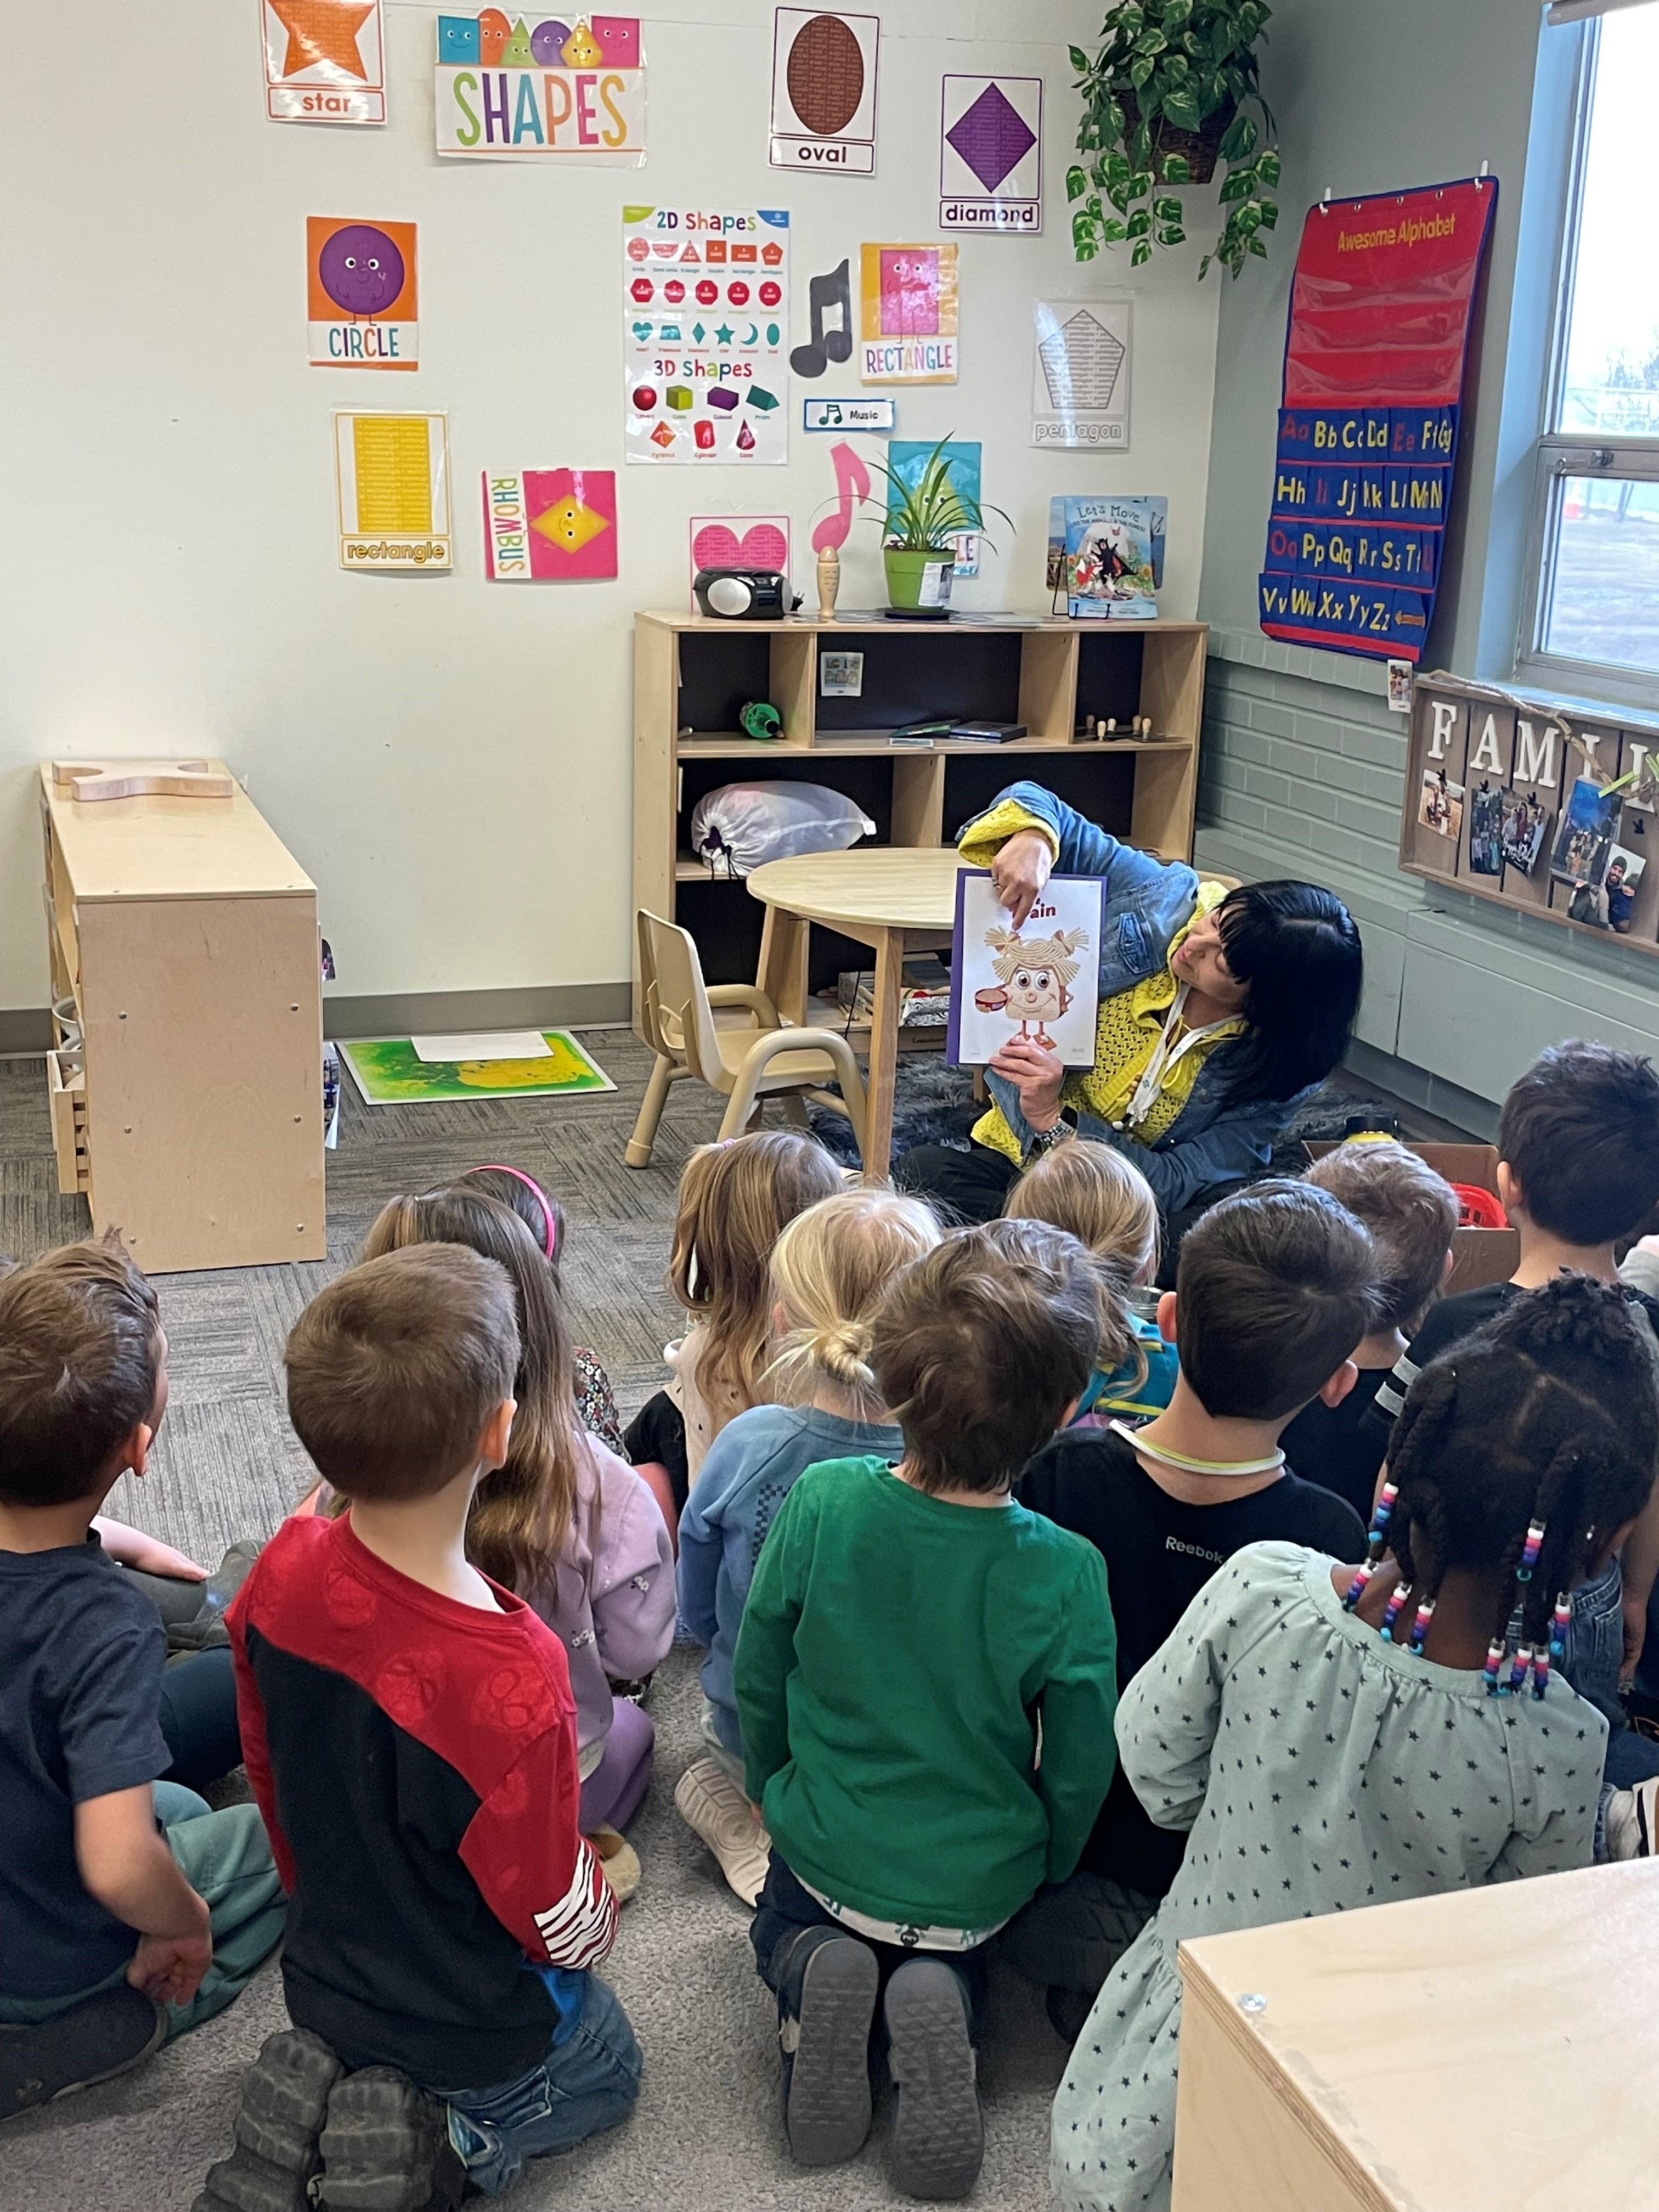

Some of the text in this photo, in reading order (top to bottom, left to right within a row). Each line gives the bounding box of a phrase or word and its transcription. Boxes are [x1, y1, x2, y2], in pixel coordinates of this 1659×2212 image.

[302, 93, 351, 112] star
[453, 72, 628, 147] SHAPES
[798, 145, 847, 163] oval
[657, 211, 757, 235] 2D Shapes
[945, 204, 1034, 223] diamond
[1337, 212, 1456, 253] Awesome Alphabet
[329, 328, 399, 358] CIRCLE
[654, 359, 753, 382] 3D Shapes
[866, 344, 952, 374] RECTANGLE
[850, 409, 878, 420] Music
[1035, 421, 1121, 443] pentagon
[1281, 414, 1310, 442] Aa
[1314, 420, 1337, 448] Bb
[1342, 420, 1364, 448] Cc
[1277, 476, 1306, 504] Hh
[1337, 479, 1356, 516] Jj
[491, 478, 525, 572] RHOMBUS
[1077, 505, 1140, 523] Let's Move
[347, 541, 445, 564] rectangle
[1271, 530, 1297, 558] Oo
[1302, 533, 1324, 567] Pp
[1329, 536, 1352, 573] Qq
[1358, 538, 1378, 567] Rr
[1381, 541, 1402, 572] Ss
[1263, 587, 1288, 614] Vv
[1318, 591, 1344, 620] Xx
[1348, 594, 1370, 628] Yy
[1370, 603, 1390, 631] Zz
[1165, 1536, 1224, 1564] Reebok
